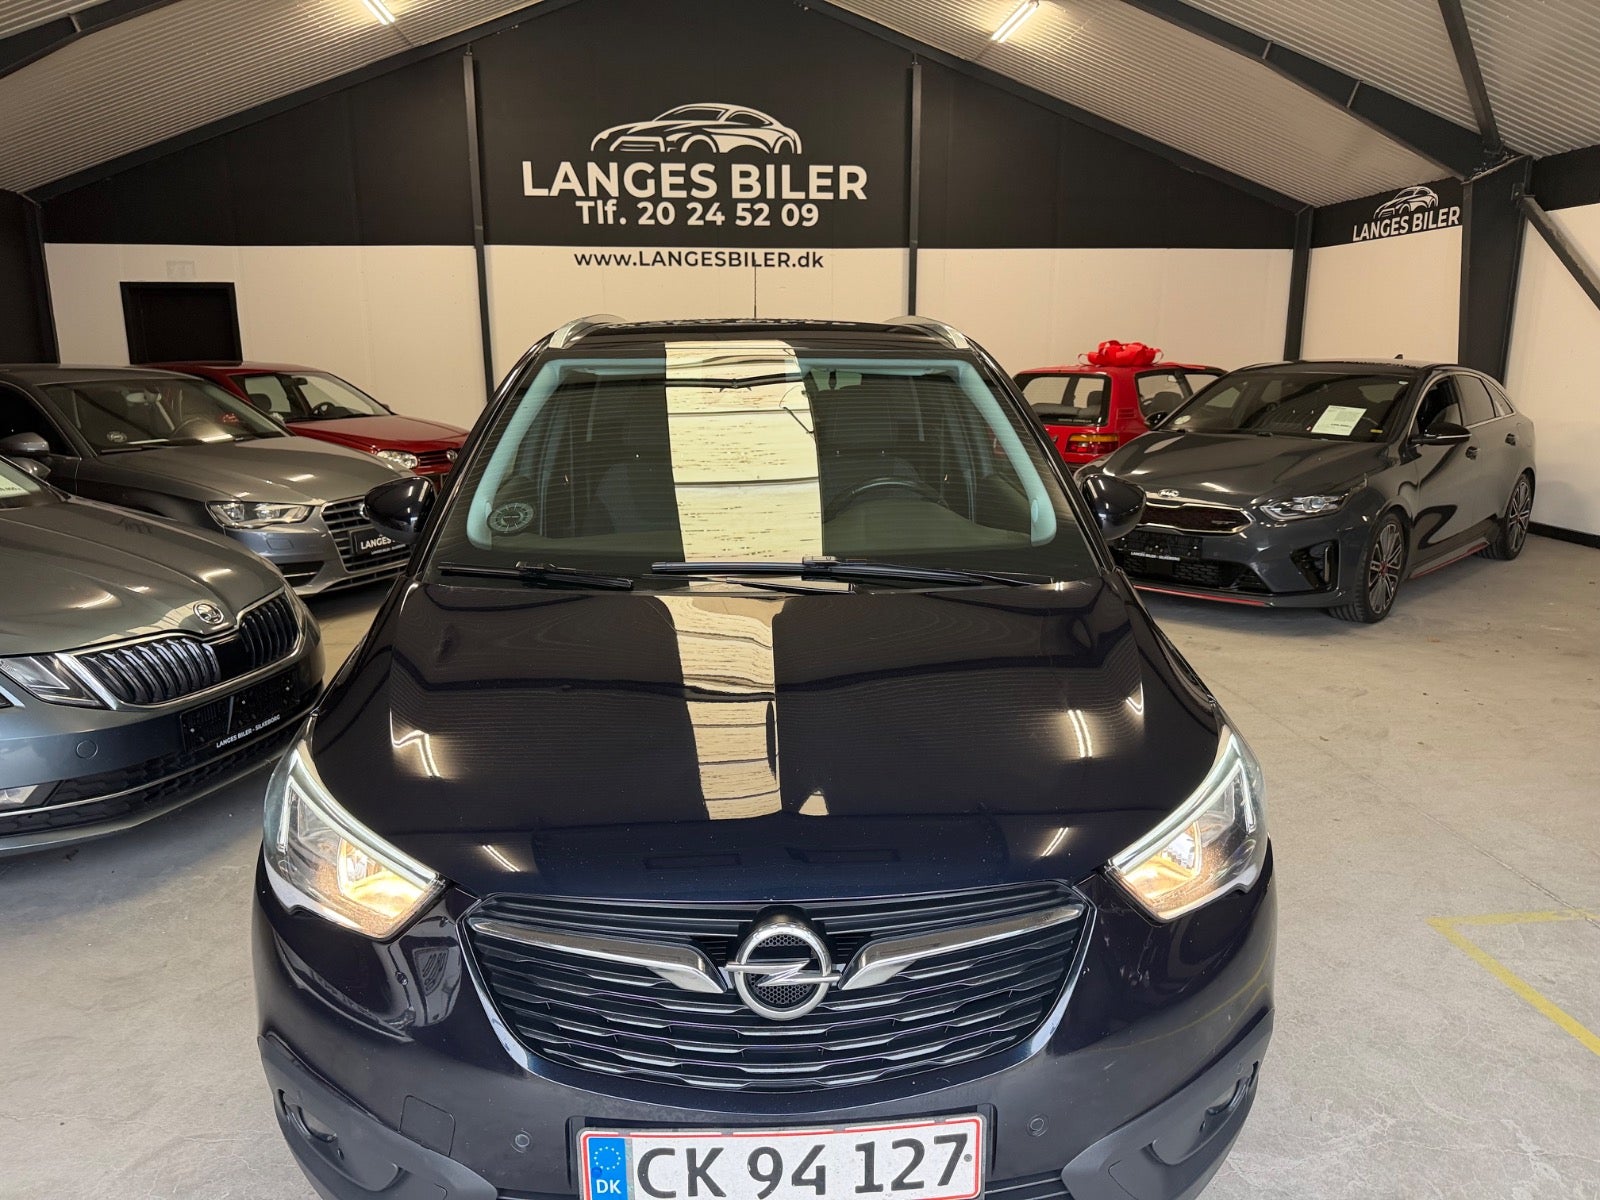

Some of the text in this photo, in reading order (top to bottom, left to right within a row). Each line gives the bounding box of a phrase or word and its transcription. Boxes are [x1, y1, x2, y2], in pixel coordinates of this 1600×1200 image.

[522, 161, 868, 200] LANGES BILER
[575, 200, 820, 227] Tlf. 20 24 52 09
[1352, 206, 1461, 242] LANGES BILER
[574, 251, 824, 268] www.LANGESBILER.dk
[637, 1133, 968, 1200] CK 94 127
[596, 1179, 622, 1195] DK
